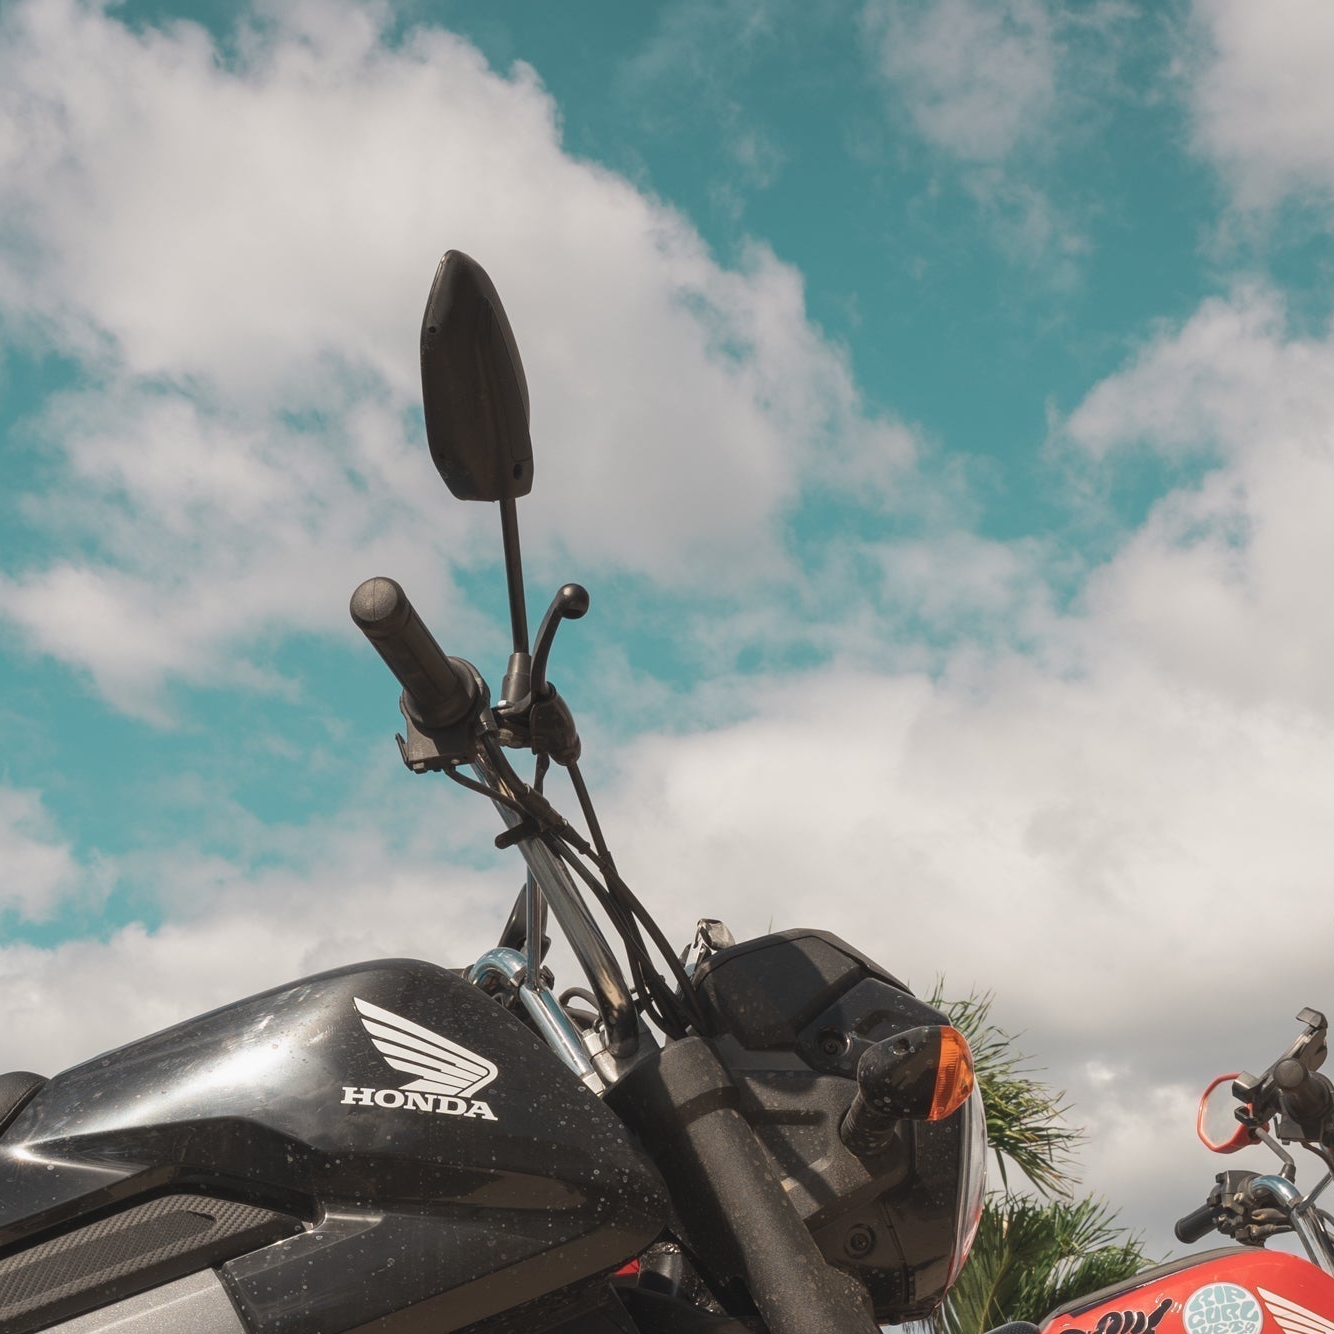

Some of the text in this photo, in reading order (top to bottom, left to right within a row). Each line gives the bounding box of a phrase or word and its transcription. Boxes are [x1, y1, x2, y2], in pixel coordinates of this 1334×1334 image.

[340, 1086, 499, 1121] HONDA
[1188, 1285, 1247, 1312] RIP
[1188, 1301, 1259, 1330] CURL
